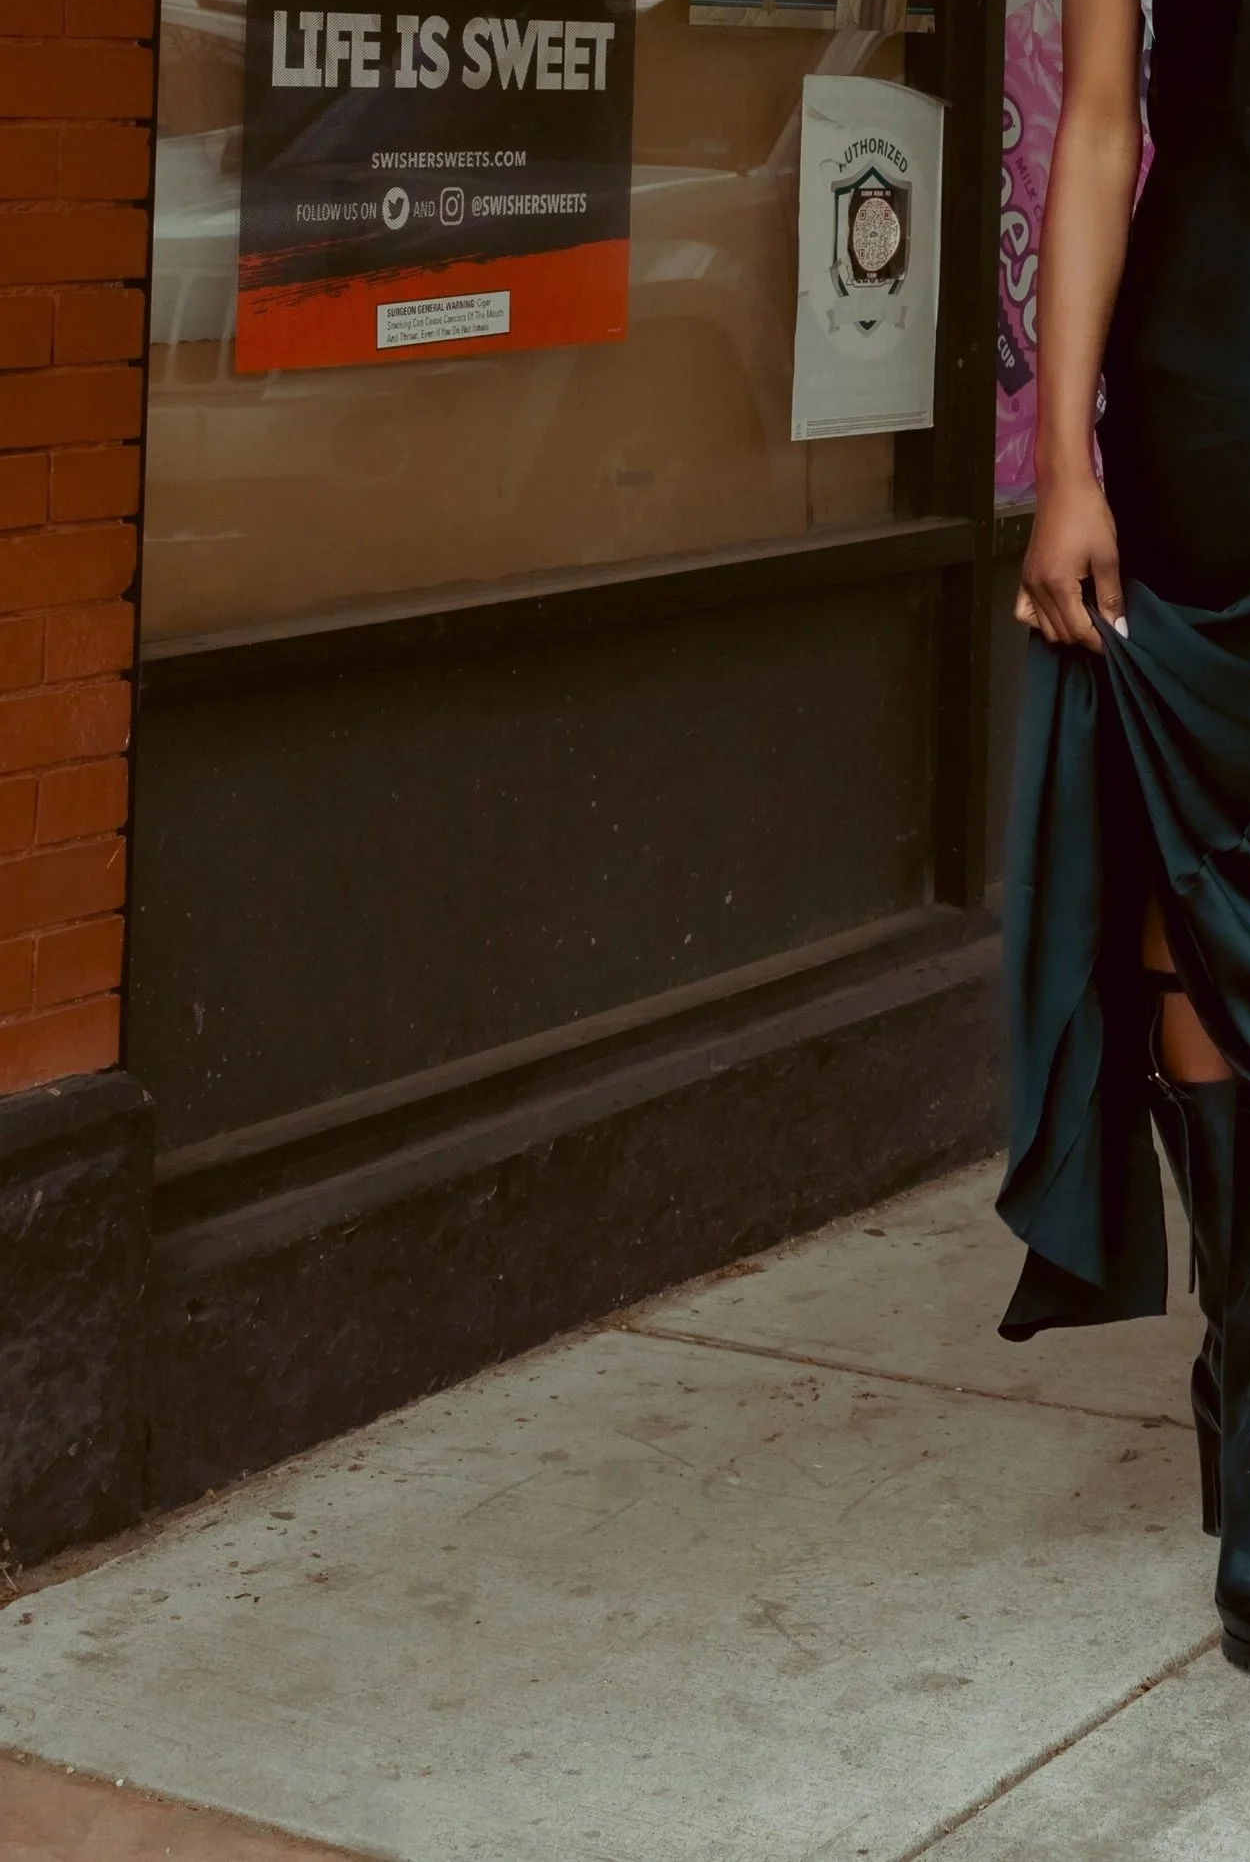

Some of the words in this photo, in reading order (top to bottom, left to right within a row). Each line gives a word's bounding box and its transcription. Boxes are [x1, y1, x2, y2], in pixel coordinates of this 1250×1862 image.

[272, 10, 381, 88] LIFE
[395, 15, 450, 90] IS
[462, 16, 615, 90] SWEET
[371, 150, 528, 170] SWISHERSWEETS.COM
[296, 202, 342, 221] FOLLOW
[343, 202, 359, 220] US
[360, 201, 377, 219] ON
[413, 200, 436, 218] AND
[472, 192, 588, 217] @SWISHERSWEETS
[387, 305, 416, 318] SURGEON
[417, 302, 444, 315] GENERAL
[998, 334, 1015, 368] CUP
